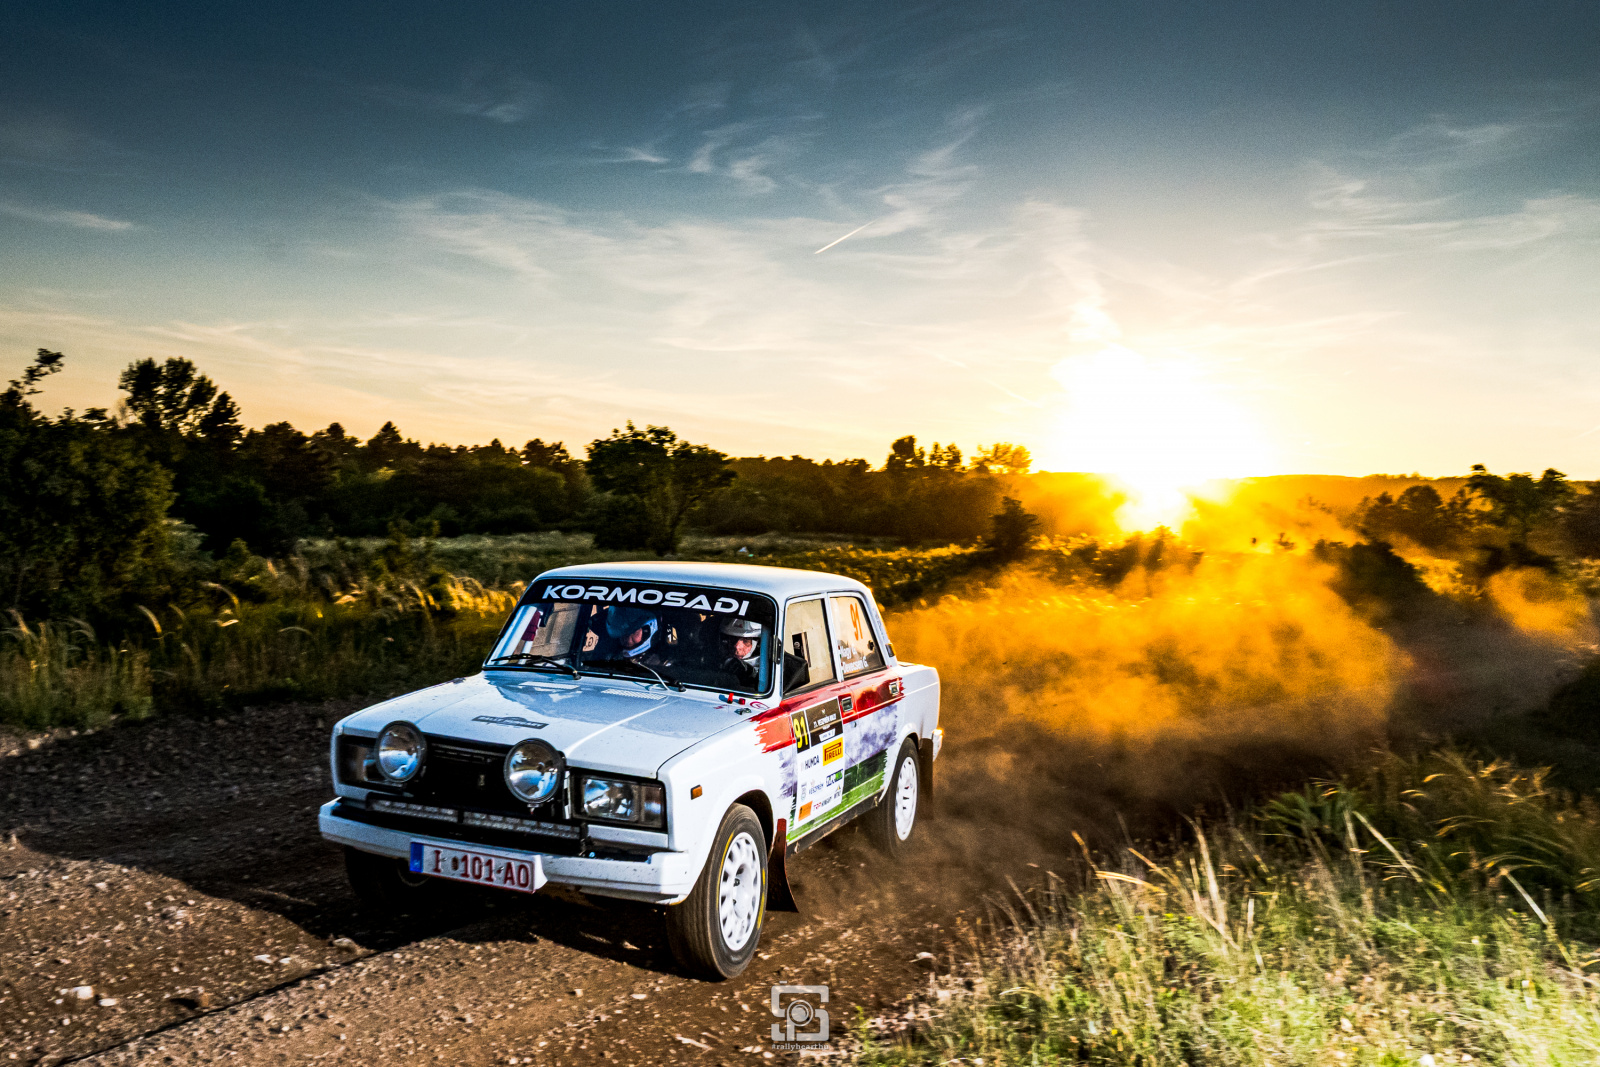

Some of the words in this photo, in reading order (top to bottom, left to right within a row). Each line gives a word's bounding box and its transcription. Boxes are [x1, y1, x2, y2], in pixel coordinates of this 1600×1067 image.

[542, 585, 750, 616] KORMOSADI
[850, 602, 864, 641] 91
[793, 716, 809, 749] 91
[824, 741, 842, 762] PIRELLI
